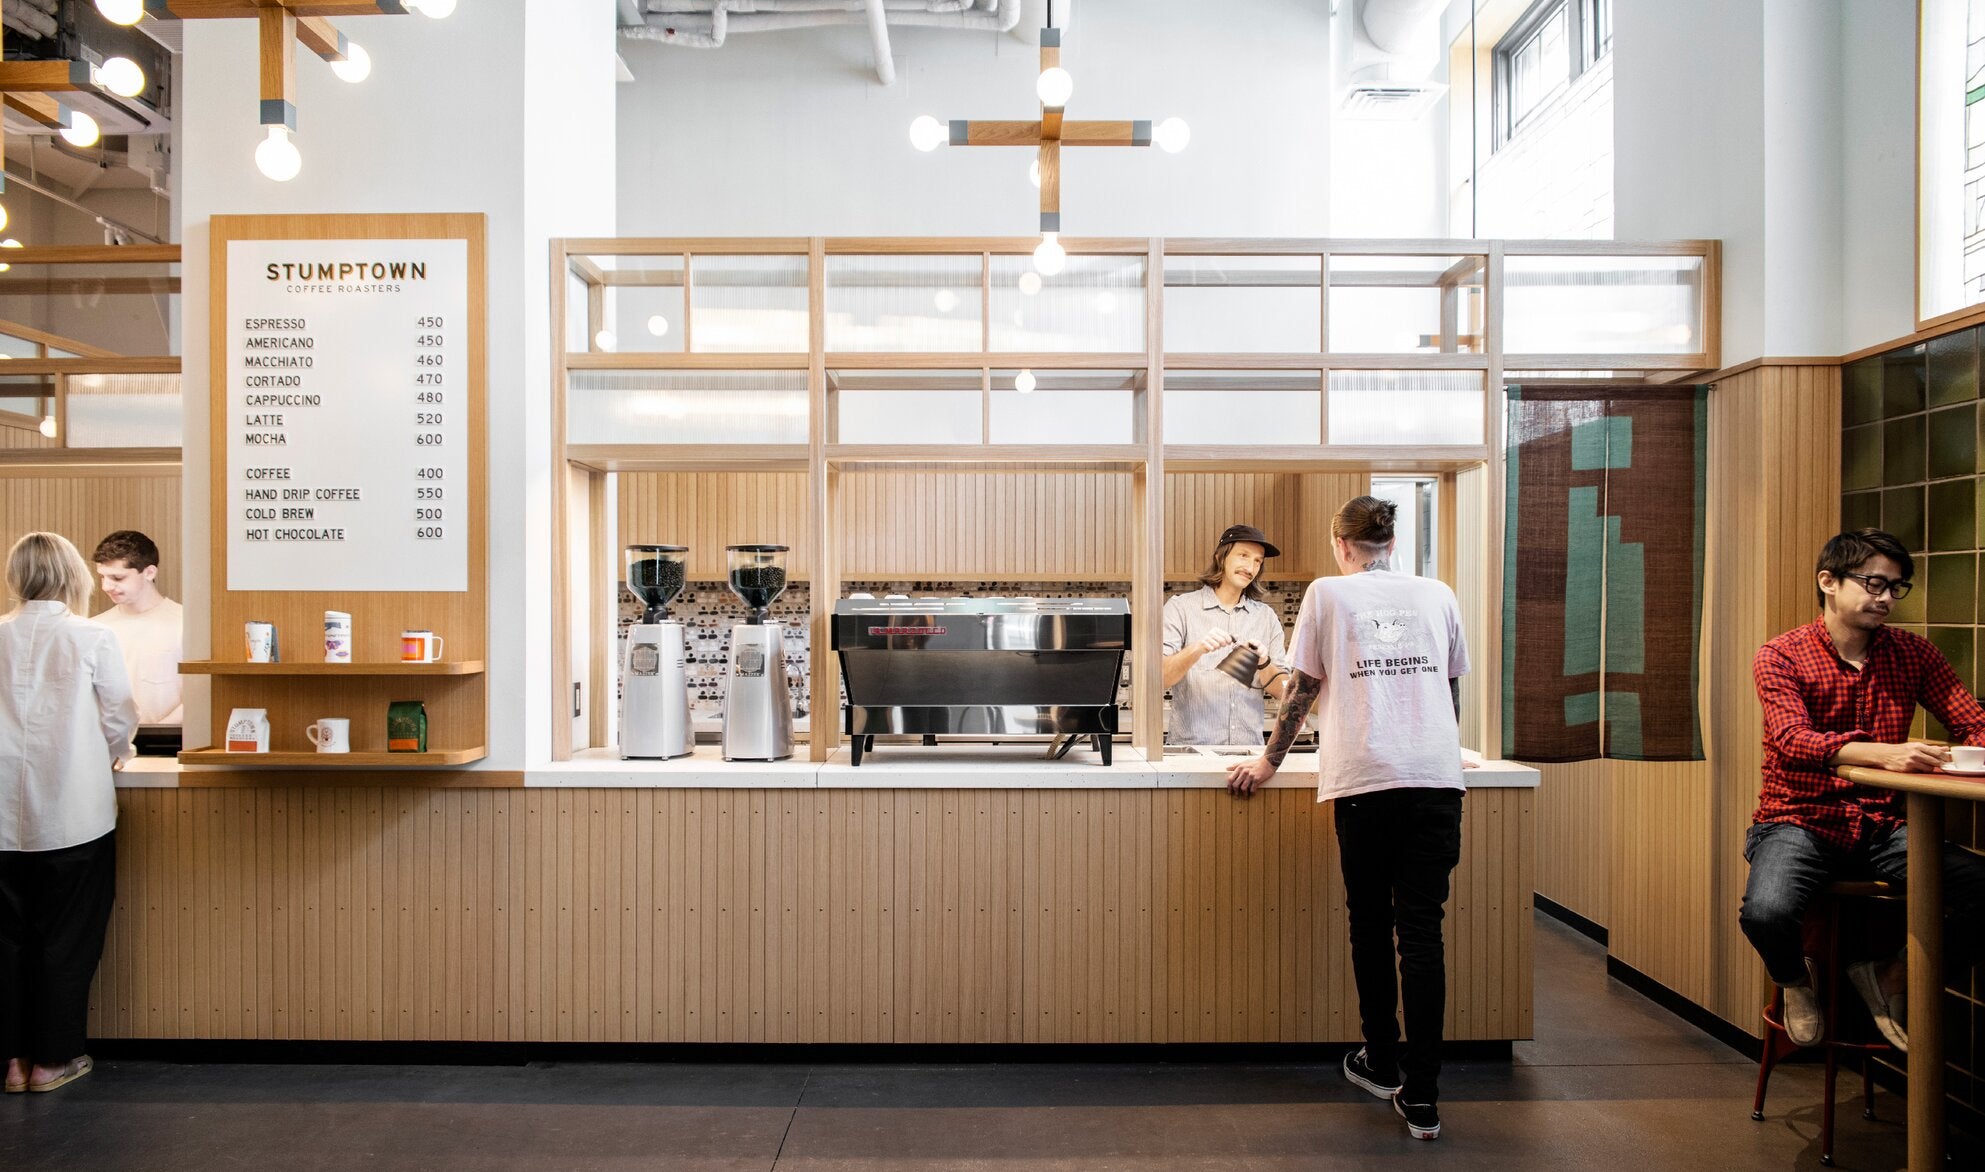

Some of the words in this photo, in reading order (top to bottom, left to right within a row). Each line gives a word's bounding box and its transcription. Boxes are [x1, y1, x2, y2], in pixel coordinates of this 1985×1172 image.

[266, 262, 428, 281] STUMPTOWN
[286, 284, 333, 293] COFFEE
[337, 284, 402, 293] ROASTERS
[244, 318, 306, 330] ESPRESSO
[417, 316, 444, 328] 450
[245, 337, 314, 348] AMERICANO
[417, 335, 444, 346] 450
[244, 356, 314, 368] MACCHIATO
[417, 354, 444, 366] 460
[245, 375, 302, 387] CORTADO
[416, 373, 443, 385] 470
[245, 394, 321, 406] CAPPUCCINO
[417, 392, 444, 404] 480
[245, 414, 284, 426] LATTE
[416, 413, 443, 424] 520
[244, 433, 287, 445] MOCHA
[416, 433, 443, 445] 600
[245, 467, 291, 479] COFFEE
[417, 467, 444, 479] 400
[244, 488, 278, 500] HAND
[282, 488, 311, 500] DRIP
[315, 488, 361, 500] COFFEE
[417, 487, 444, 499] 550
[245, 508, 277, 520] COLD
[281, 508, 315, 519] BREW
[416, 508, 443, 520] 500
[246, 528, 269, 540] HOT
[274, 528, 345, 540] CHOCOLATE
[417, 527, 444, 538] 600
[1356, 659, 1382, 669] LIFE
[1385, 655, 1429, 667] BEGINS
[1349, 669, 1376, 680] WHEN
[1400, 667, 1418, 675] GET
[1421, 665, 1439, 673] ONE
